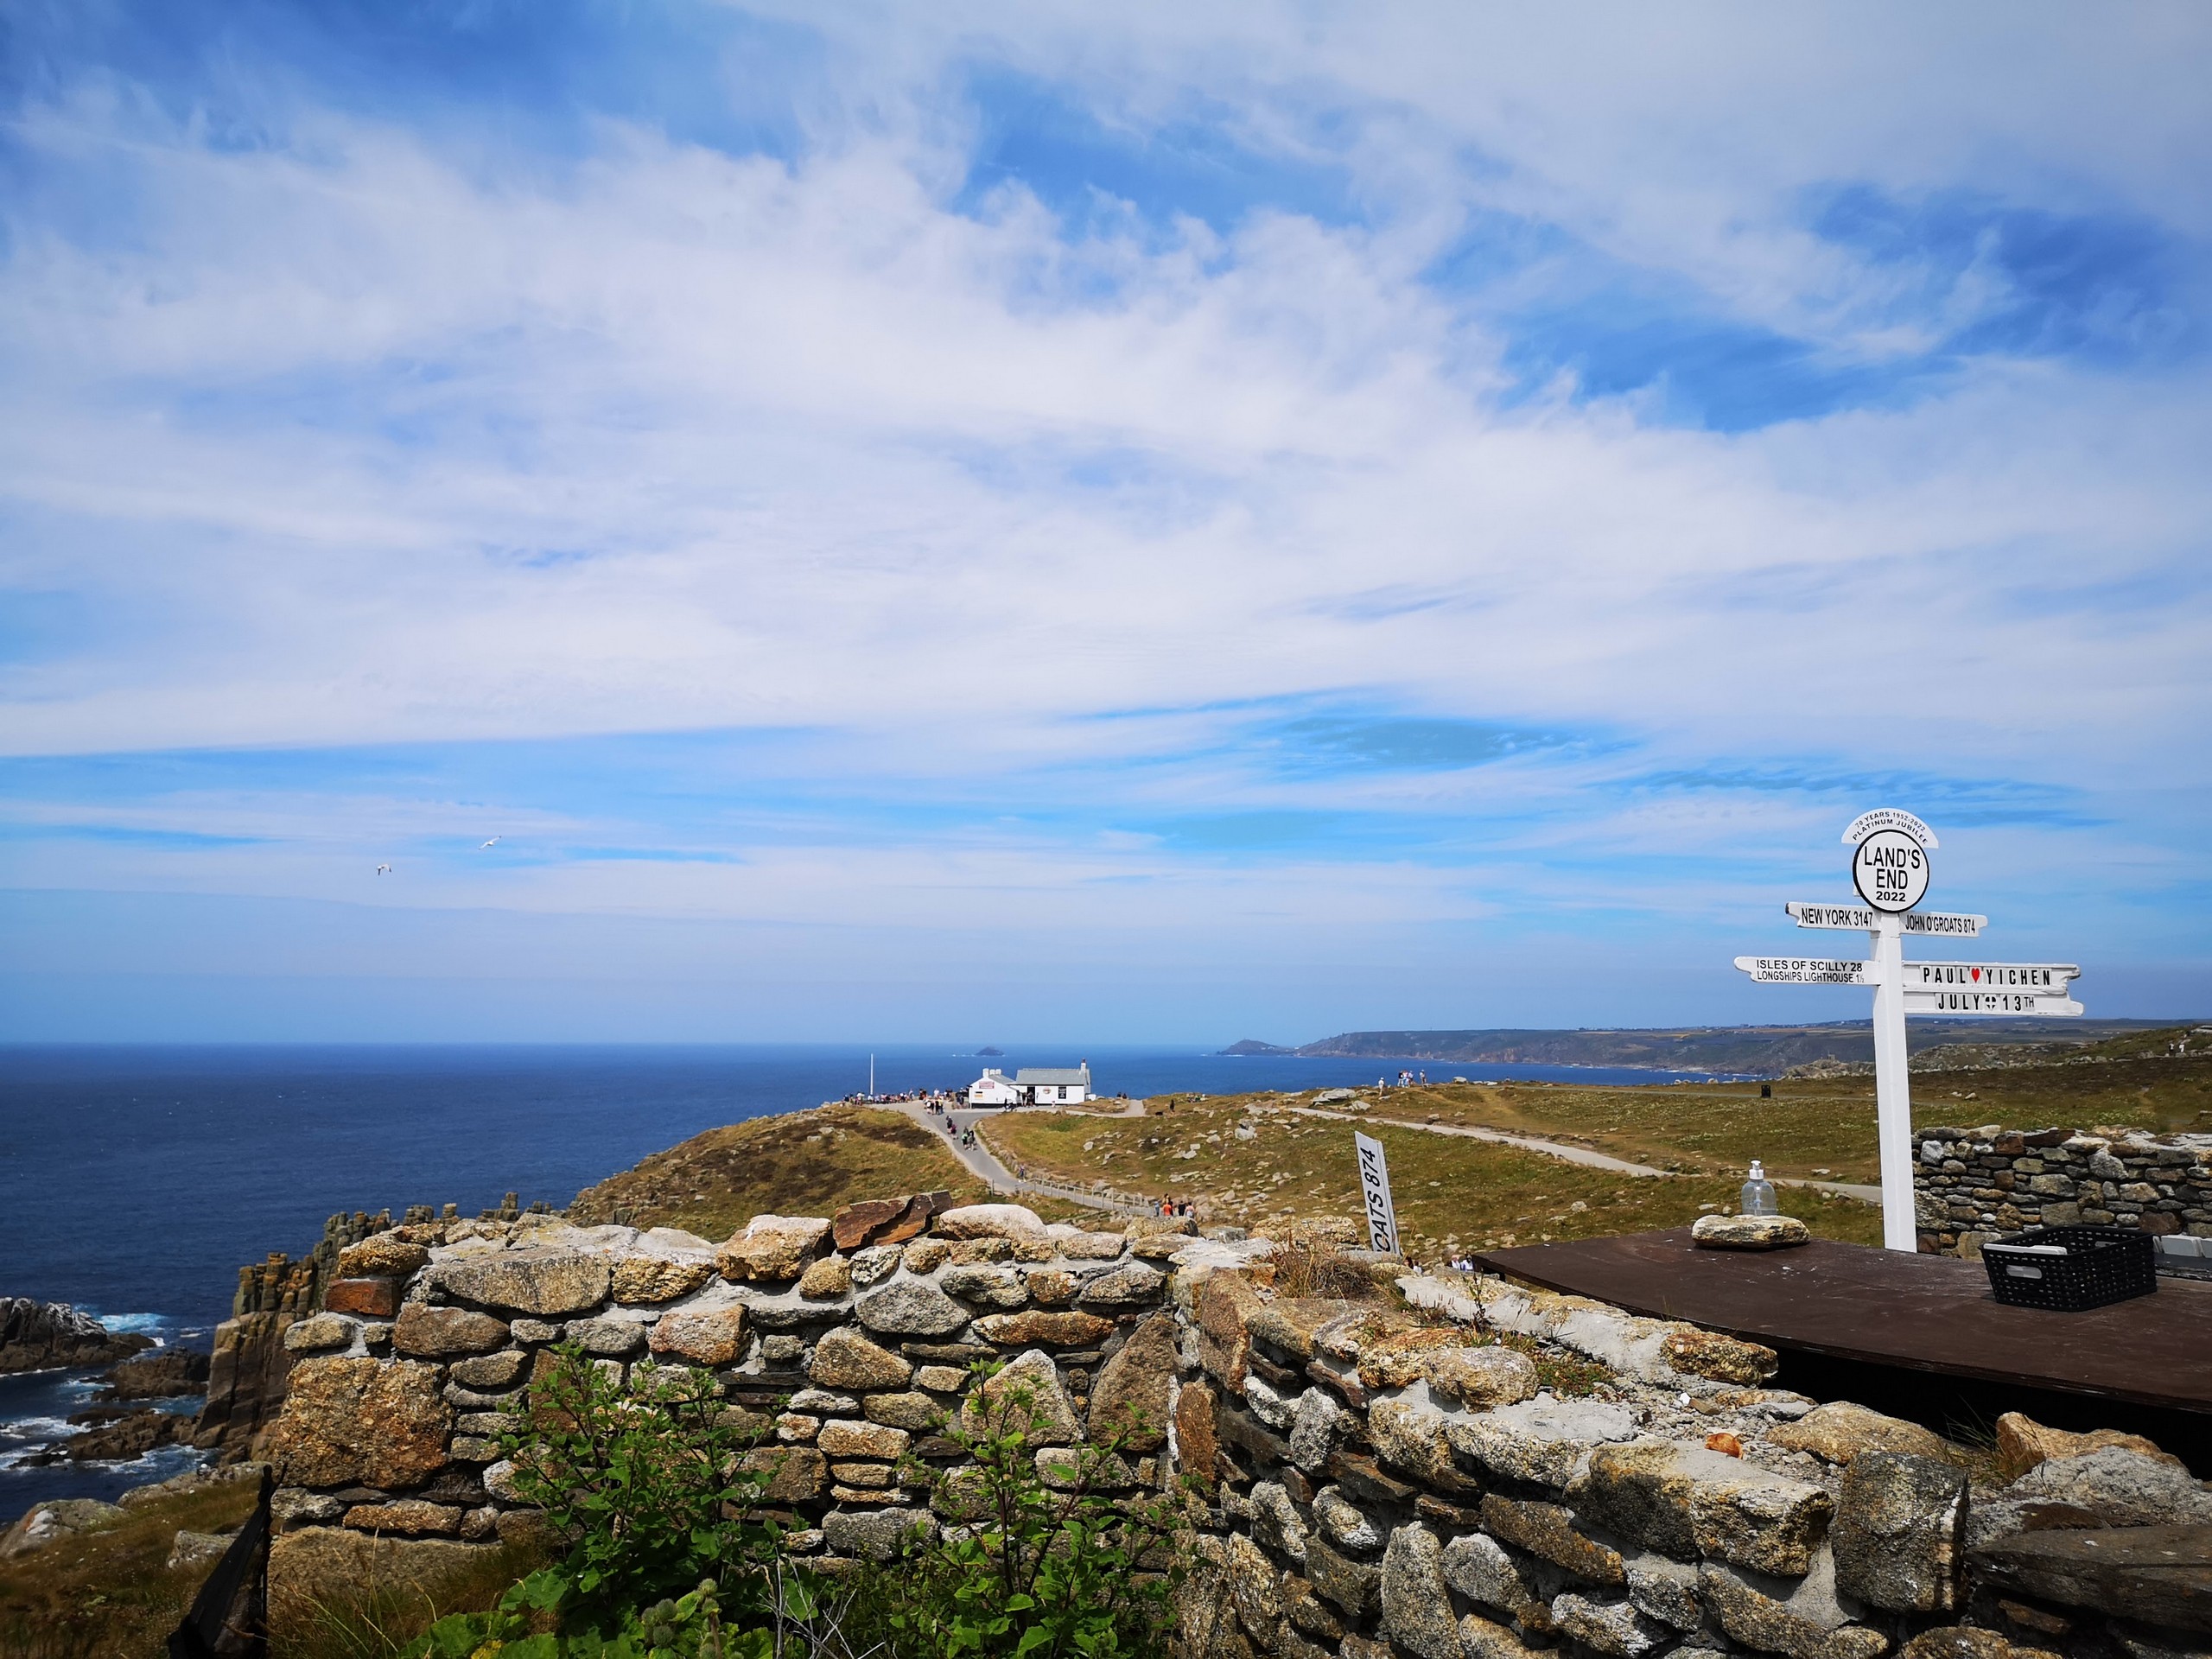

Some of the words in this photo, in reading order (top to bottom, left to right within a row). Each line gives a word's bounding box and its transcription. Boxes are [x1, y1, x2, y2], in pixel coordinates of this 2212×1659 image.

[1865, 811, 1890, 822] YEARS
[1892, 812, 1926, 832] 1952-2022
[1853, 819, 1893, 841] PLATINUM
[1896, 820, 1928, 844] JUBILEE
[1864, 846, 1921, 869] LAND'S
[1877, 868, 1908, 889] END
[1876, 891, 1906, 902] 2022
[1802, 907, 1823, 925] NEW
[1825, 909, 1852, 925] YORK
[1853, 911, 1873, 927] 3147
[1905, 914, 1925, 931] JOHN
[1926, 916, 1962, 933] O'GROATS
[1963, 918, 1976, 933] 874
[1757, 959, 1788, 969] ISLES
[1791, 960, 1807, 970] OF
[1809, 961, 1847, 971] SCILLY
[1850, 962, 1863, 972] 28
[1757, 970, 1802, 982] LONGSHIPS
[1804, 972, 1853, 982] LIGHTHOUSE
[1923, 967, 1966, 984] PAUL
[1986, 969, 2050, 985] YICHEN
[1938, 993, 1980, 1010] JULY
[1360, 1147, 1381, 1187] 874
